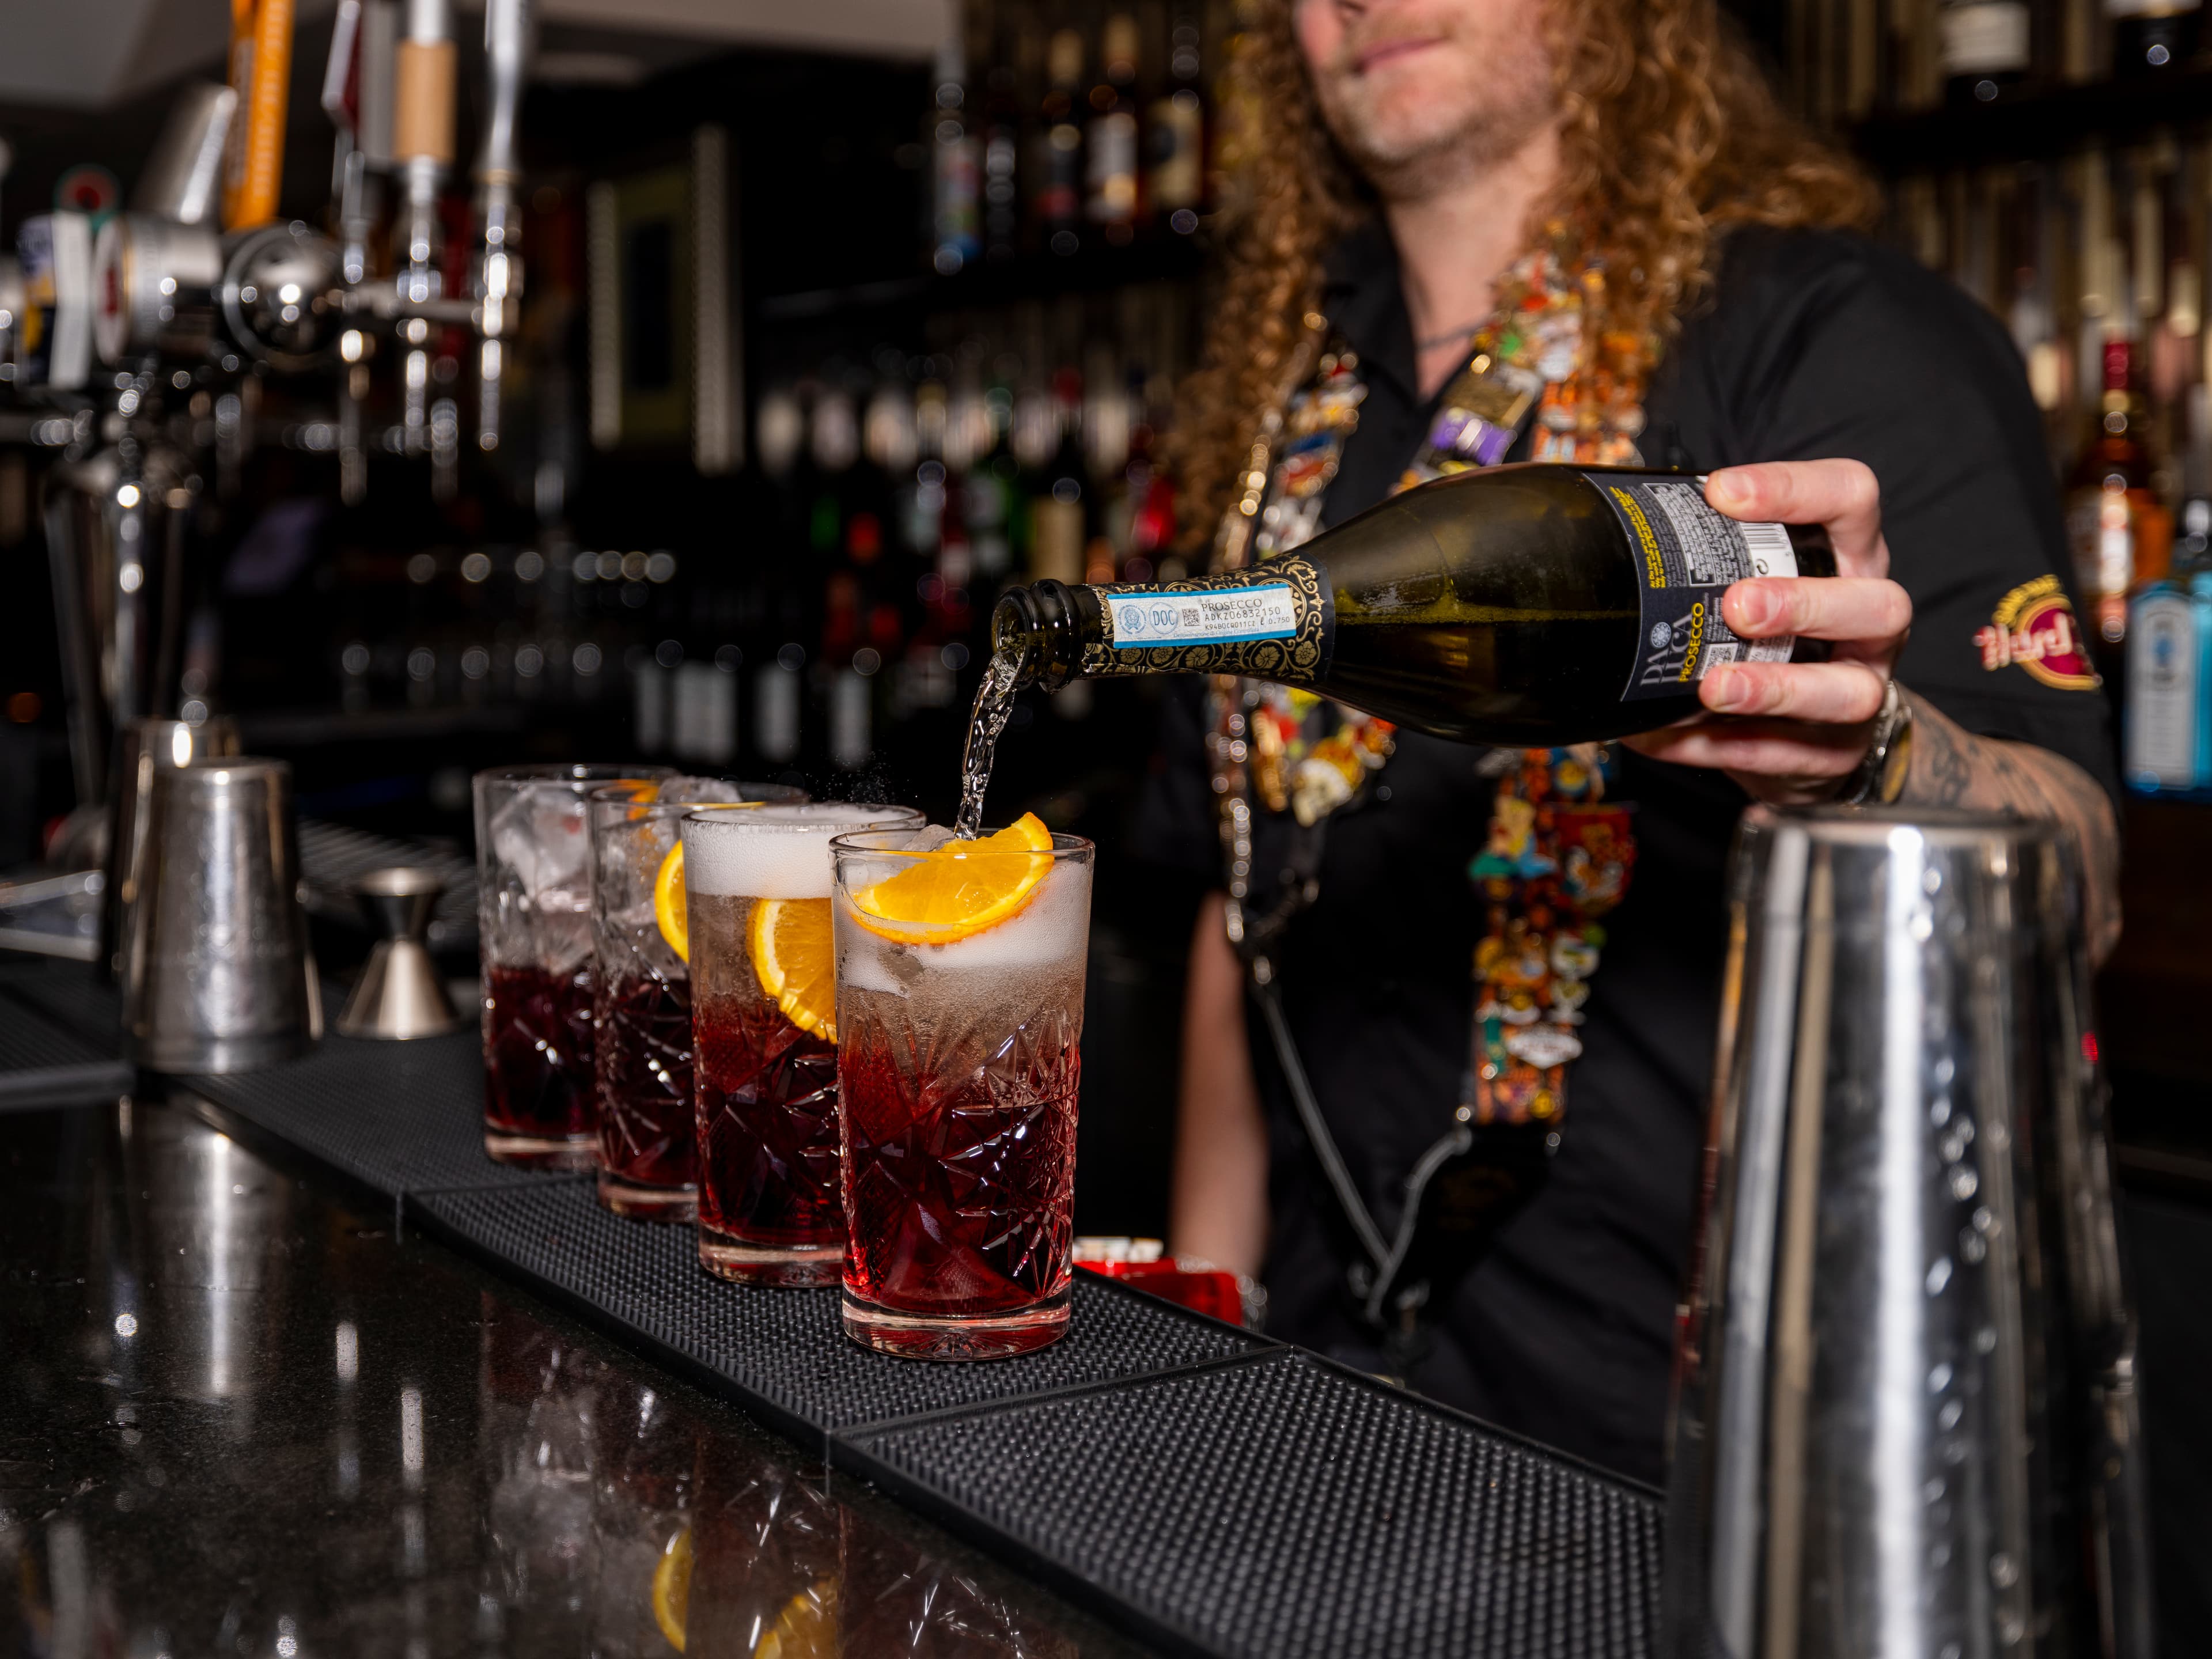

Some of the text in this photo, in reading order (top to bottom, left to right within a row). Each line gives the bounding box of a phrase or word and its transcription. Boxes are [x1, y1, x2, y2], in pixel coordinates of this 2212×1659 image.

[1201, 599, 1262, 612] PROSECCO
[1153, 609, 1175, 626] DOC
[1205, 607, 1281, 622] ADKZ06832150
[1268, 616, 1290, 624] 0.750
[1662, 612, 1693, 683] LUCA
[1679, 603, 1704, 682] PROSECCO
[1640, 648, 1669, 686] DA
